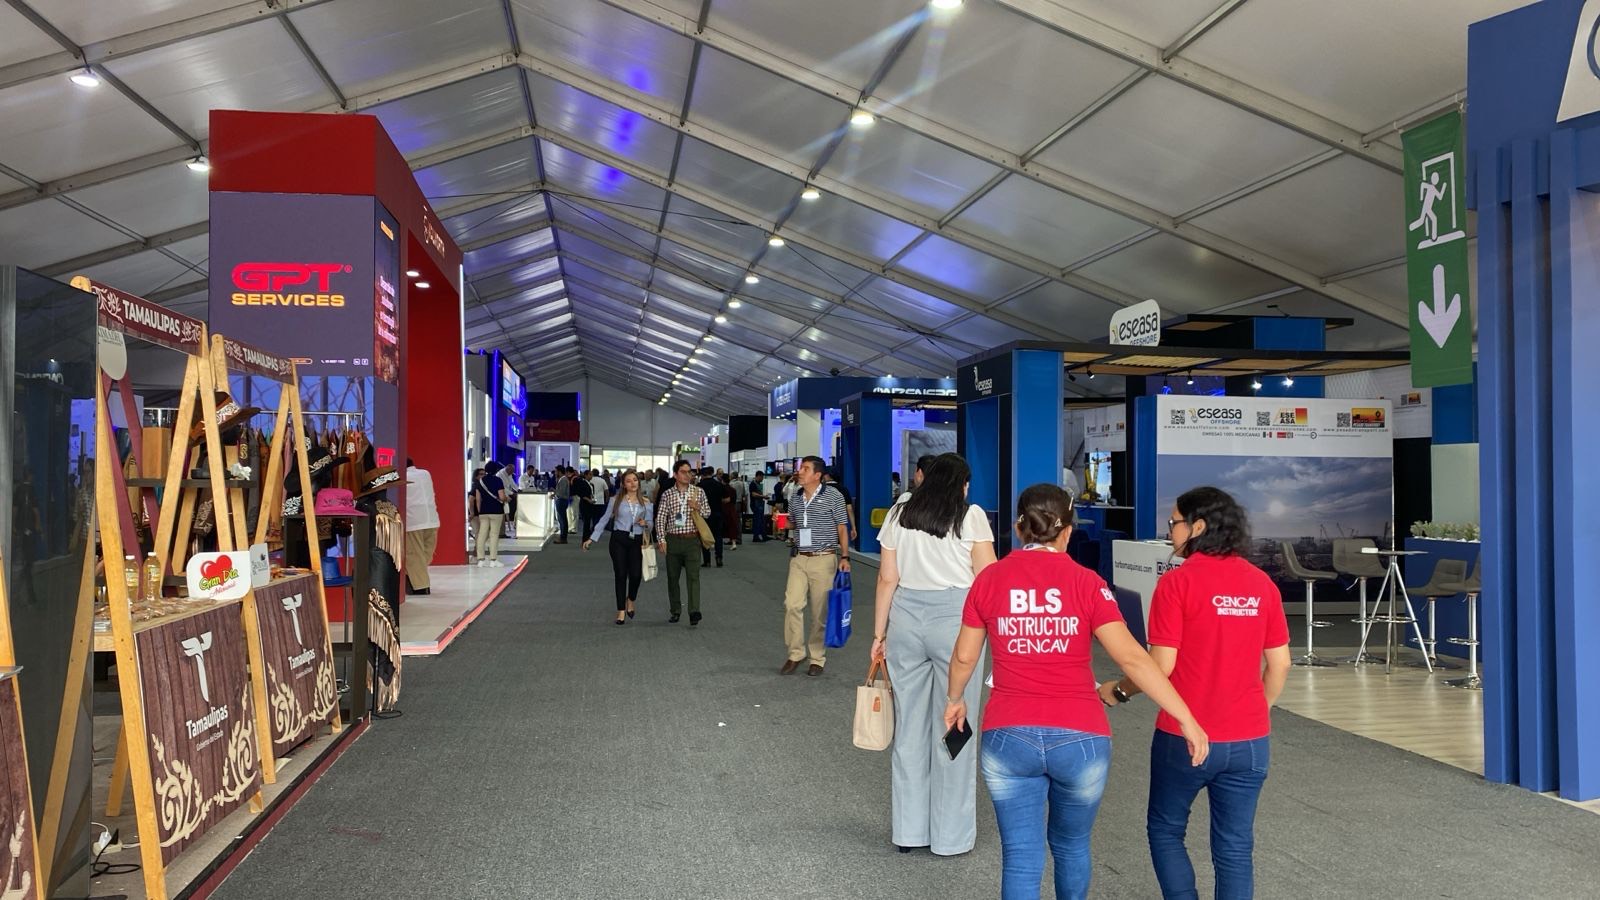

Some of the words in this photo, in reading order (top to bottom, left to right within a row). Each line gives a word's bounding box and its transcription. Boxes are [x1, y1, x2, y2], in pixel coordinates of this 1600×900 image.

[231, 293, 345, 307] SERVICES
[123, 299, 181, 337] TAMAULIPAS
[1119, 312, 1158, 341] eseasa
[242, 347, 279, 371] TAMAULIPAS
[1197, 408, 1242, 419] eseasa
[1009, 588, 1063, 614] BLS
[1211, 595, 1261, 608] CENCAV
[1217, 607, 1259, 616] INSTRUCTOR
[997, 616, 1080, 636] INSTRUCTOR
[1007, 638, 1070, 654] CENCAV
[288, 648, 316, 671] Tamaulipas
[186, 704, 229, 740] Tamaulipas
